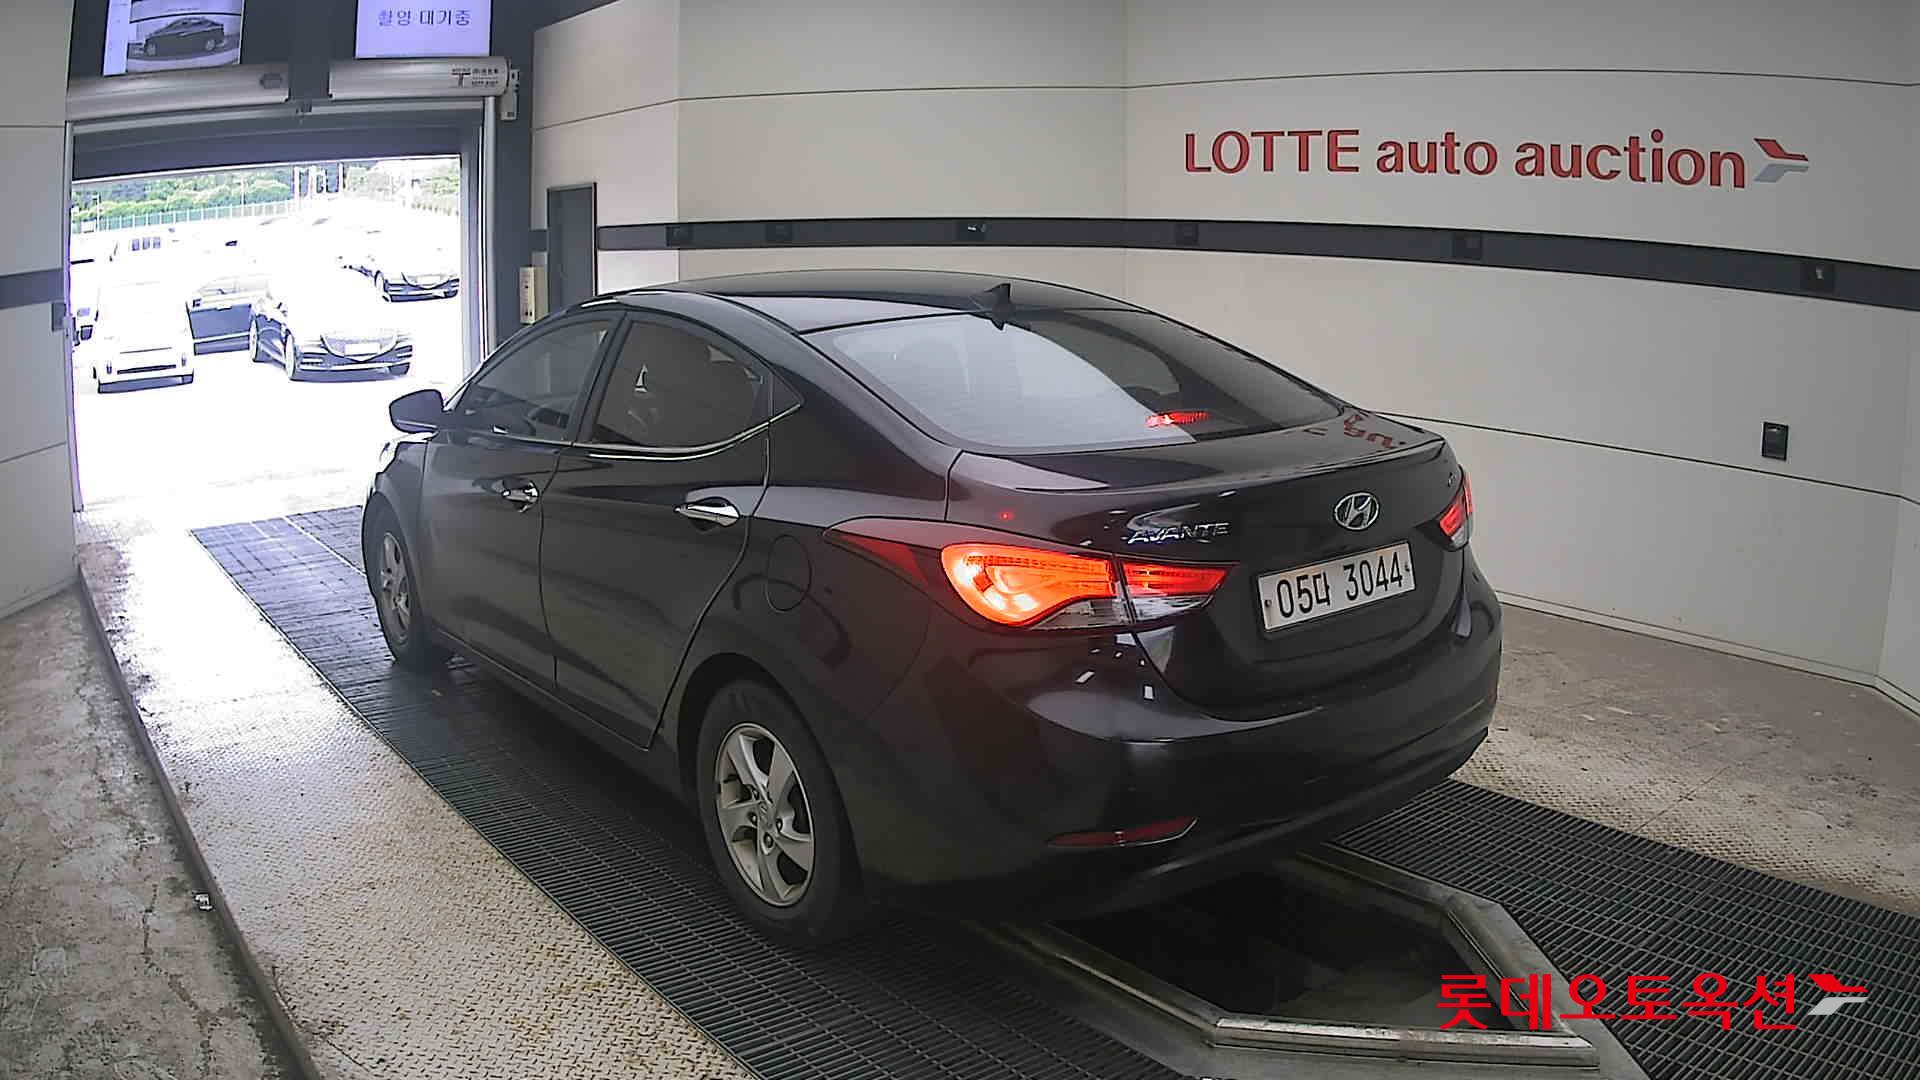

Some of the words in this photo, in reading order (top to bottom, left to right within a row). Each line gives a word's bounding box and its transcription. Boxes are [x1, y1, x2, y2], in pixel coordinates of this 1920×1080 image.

[419, 9, 471, 26] 대기중
[1185, 129, 1359, 174] LOTTE
[1377, 132, 1499, 176] auto
[1514, 129, 1746, 188] auction
[1127, 522, 1230, 545] AVANTE
[1343, 551, 1403, 601] 3044
